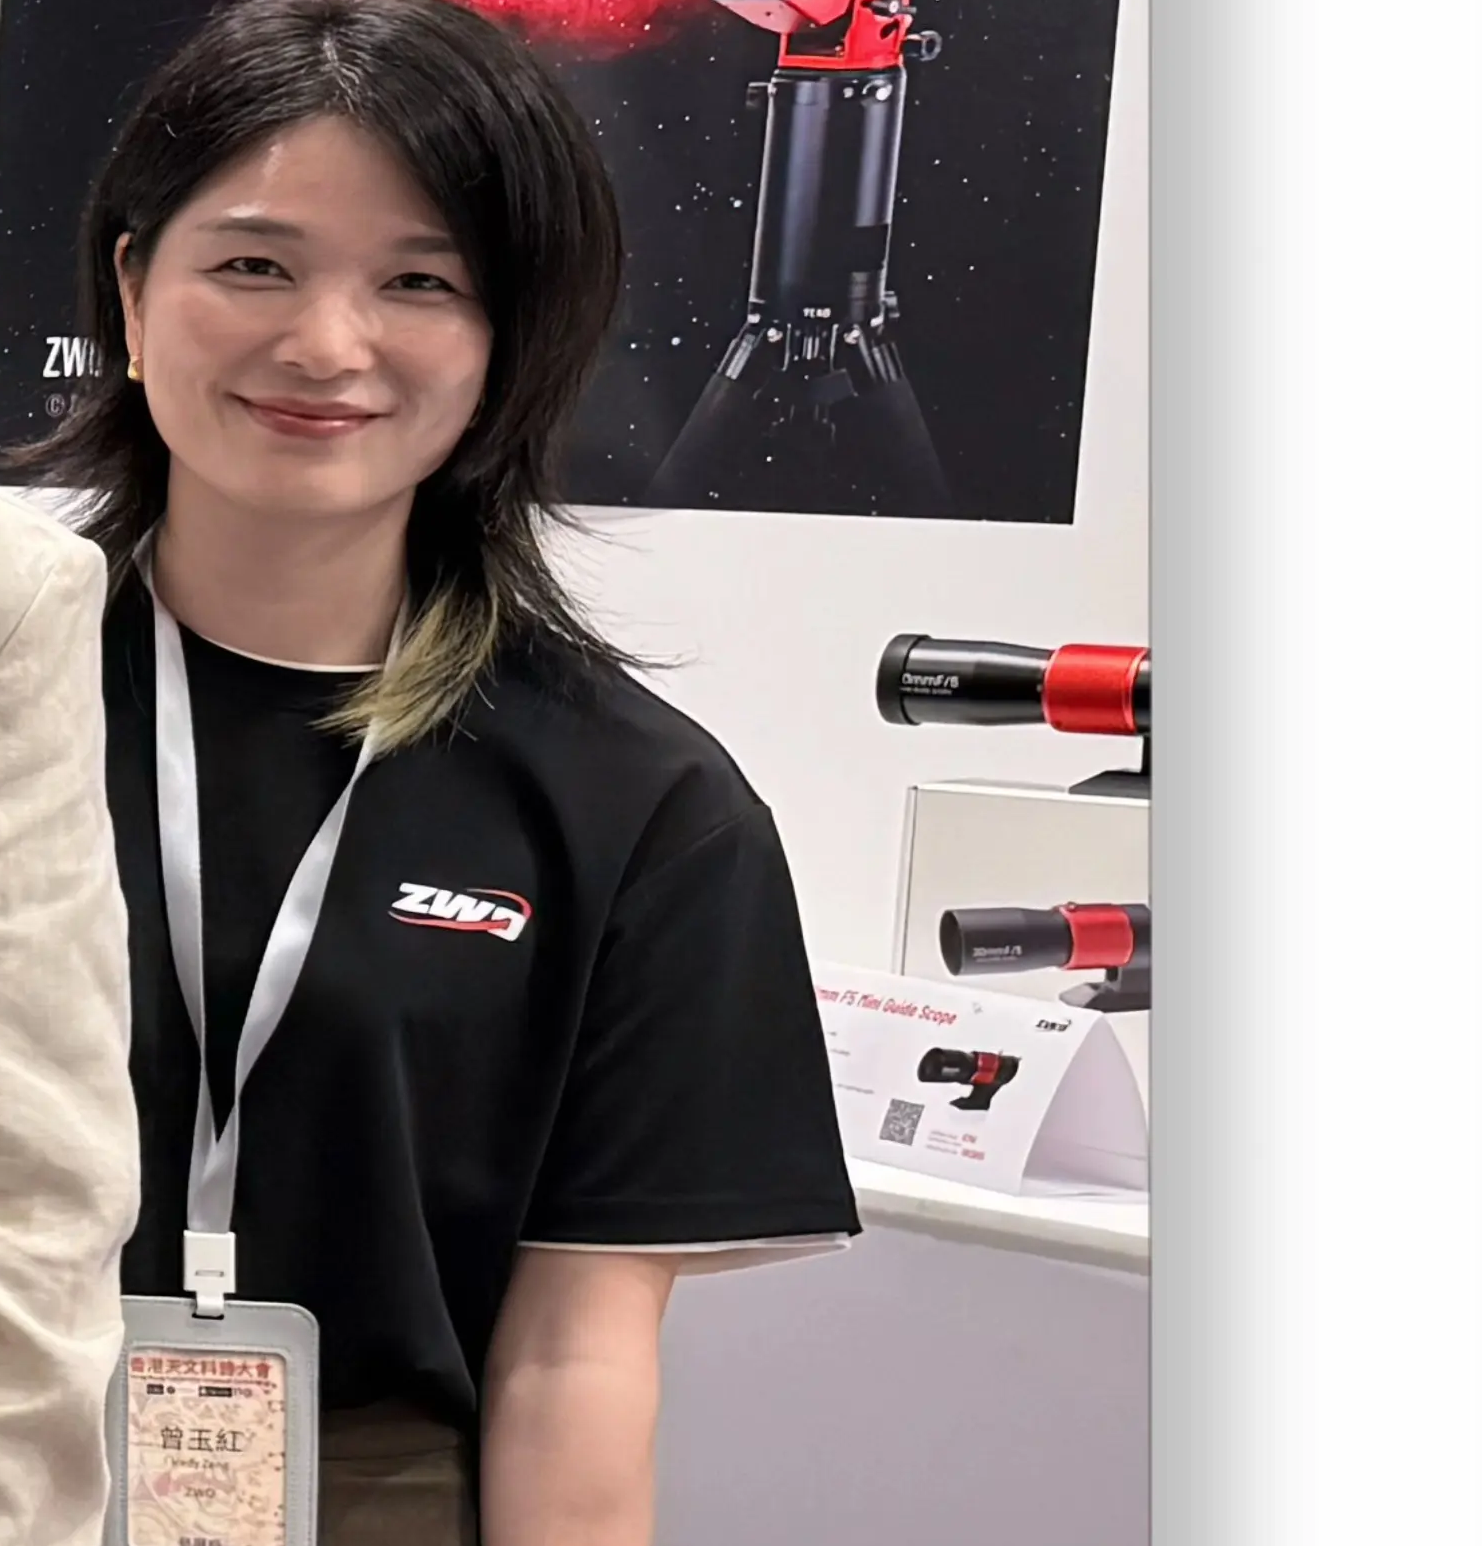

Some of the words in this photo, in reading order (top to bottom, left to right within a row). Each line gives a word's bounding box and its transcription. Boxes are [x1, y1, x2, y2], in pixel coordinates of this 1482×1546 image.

[388, 883, 533, 942] ZWO
[883, 999, 917, 1017] Guide
[919, 1006, 957, 1026] Scope
